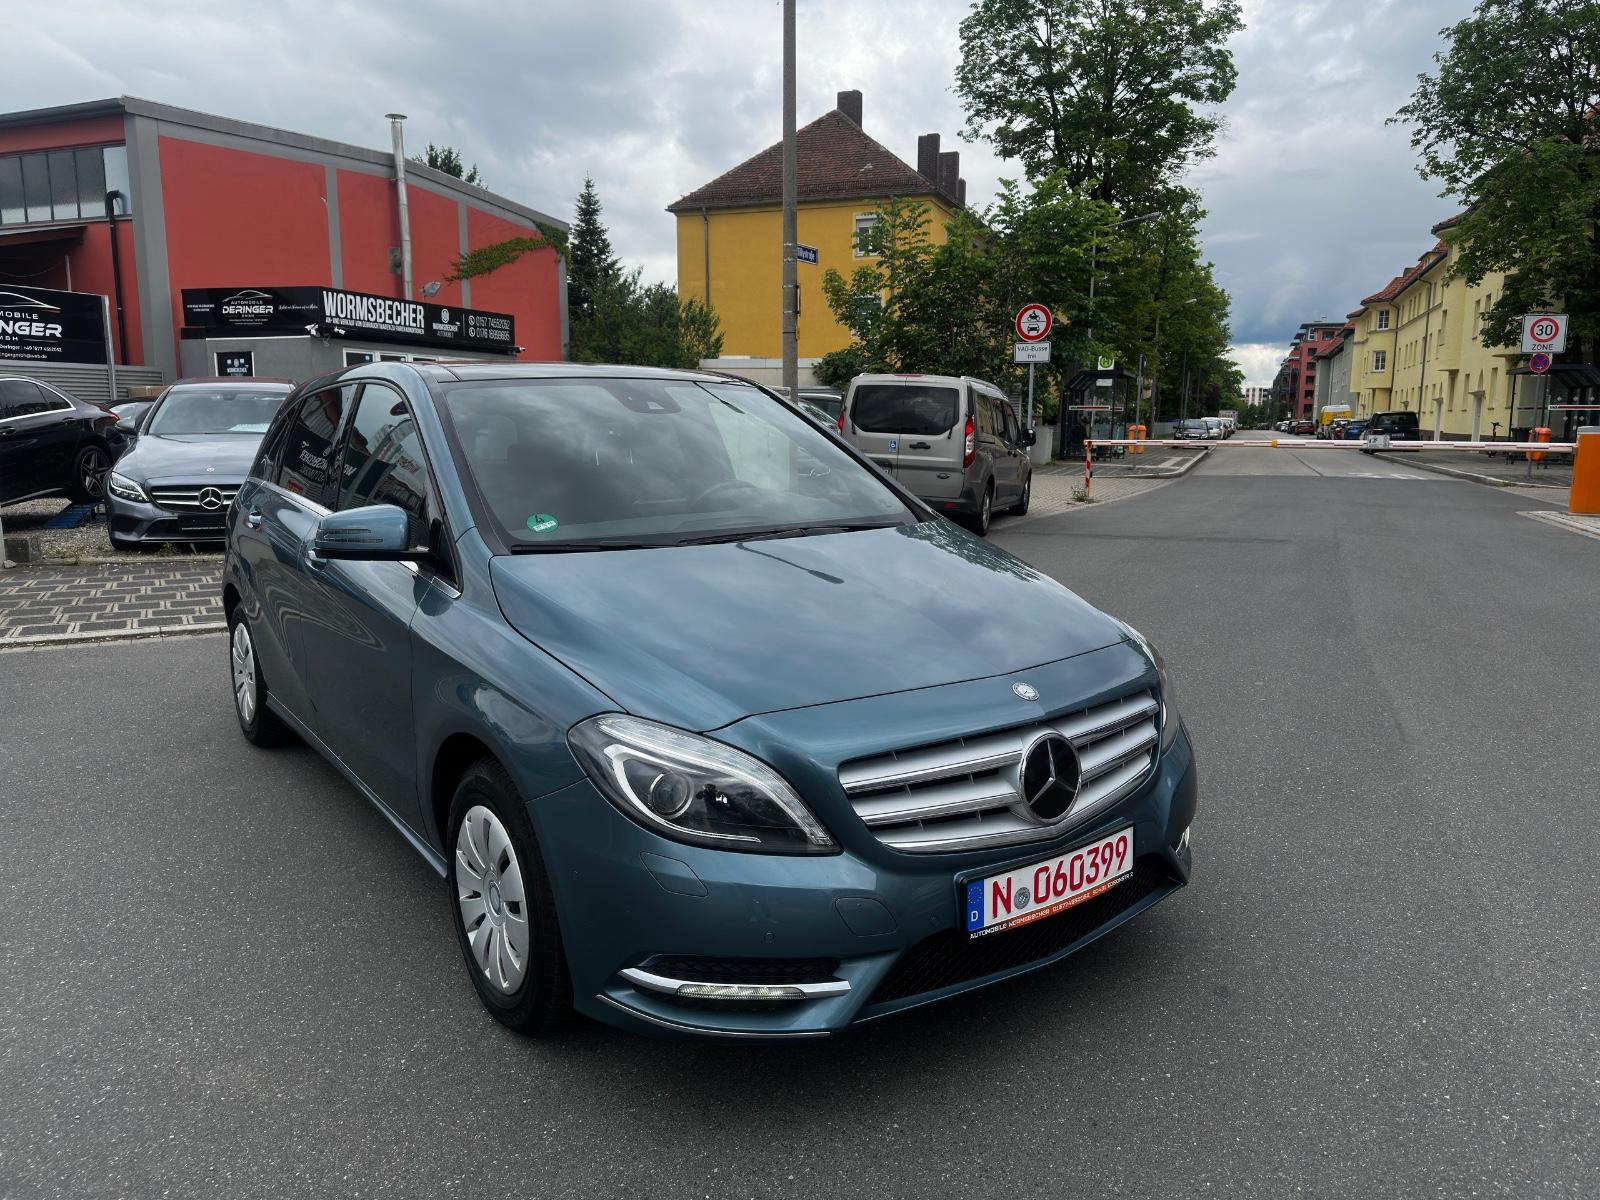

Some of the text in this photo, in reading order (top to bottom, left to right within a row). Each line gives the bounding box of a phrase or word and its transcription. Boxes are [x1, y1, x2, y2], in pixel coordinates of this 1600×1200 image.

[222, 305, 273, 314] DERINGER
[322, 290, 425, 328] WORMSBECHER
[1536, 324, 1553, 336] 30
[1531, 343, 1554, 351] ZONE
[992, 835, 1128, 919] N 060399
[971, 910, 979, 922] D
[970, 922, 1007, 940] AUTOMOBILE
